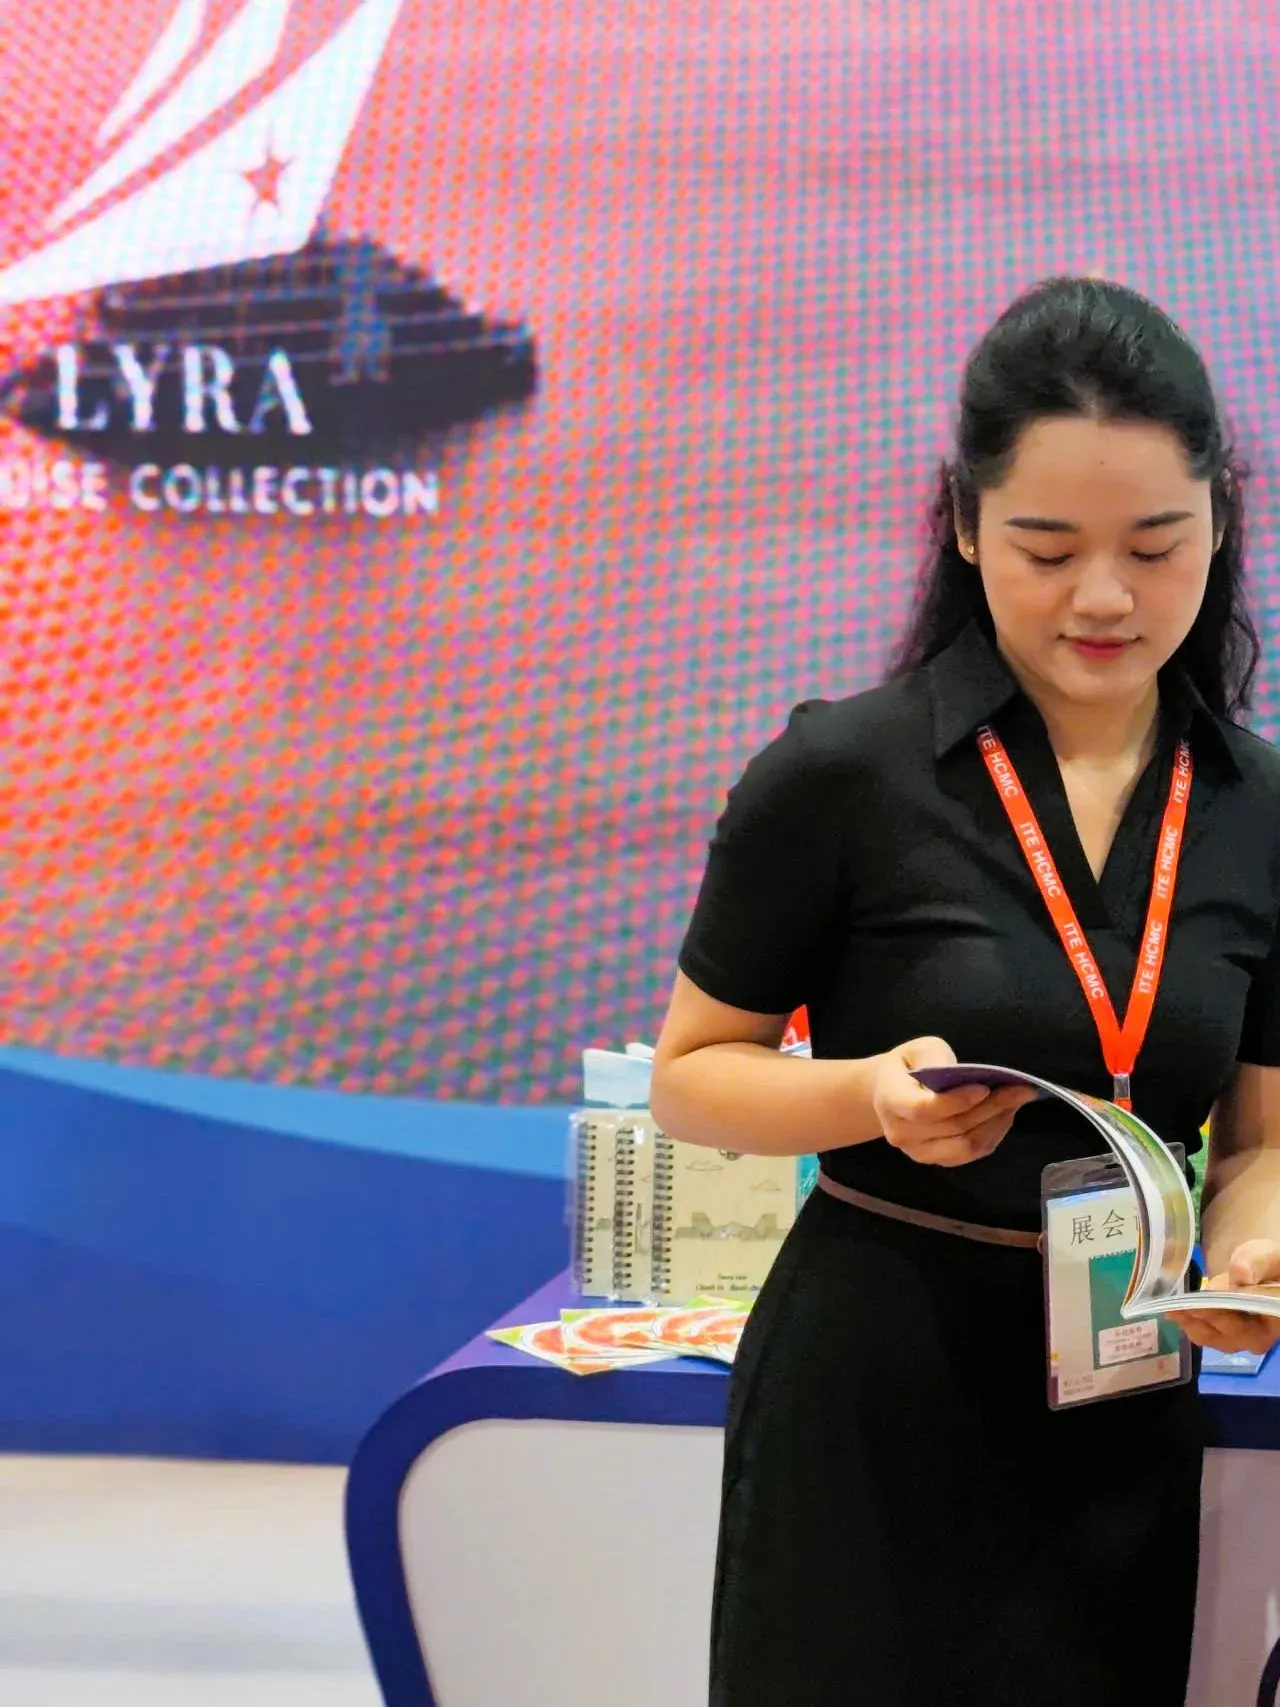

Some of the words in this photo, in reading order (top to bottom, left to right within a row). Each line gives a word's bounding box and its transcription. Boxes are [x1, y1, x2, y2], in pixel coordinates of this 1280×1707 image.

[57, 343, 313, 436] LYRA
[129, 463, 440, 517] COLLECTION
[977, 725, 997, 750] ITE
[990, 752, 1018, 798] HCMC
[1173, 778, 1188, 804] ITE
[1020, 822, 1039, 847] ITE
[1031, 851, 1061, 898] HCMC
[1162, 825, 1179, 872] HCMC
[1156, 874, 1170, 899] ITE
[1063, 922, 1082, 949] ITE
[1074, 952, 1104, 999] HCMC
[1146, 919, 1163, 967] HCMC
[1139, 969, 1155, 994] ITE
